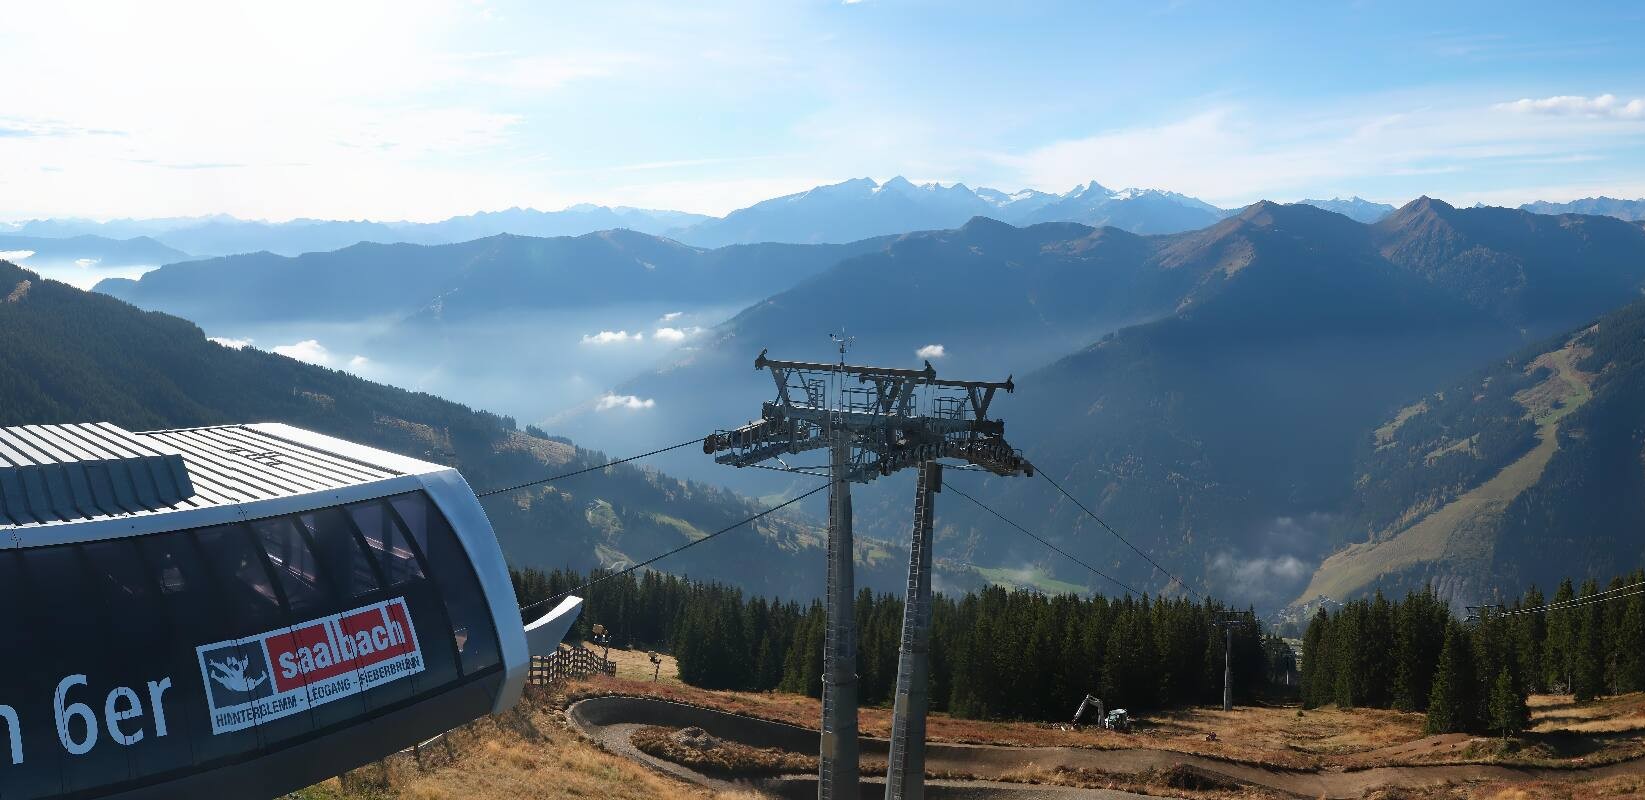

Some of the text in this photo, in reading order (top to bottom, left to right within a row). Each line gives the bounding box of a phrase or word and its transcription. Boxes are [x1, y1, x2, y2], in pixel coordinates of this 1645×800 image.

[278, 605, 405, 679] saalbach
[54, 674, 172, 755] 6er
[309, 678, 350, 702] LEOGANG
